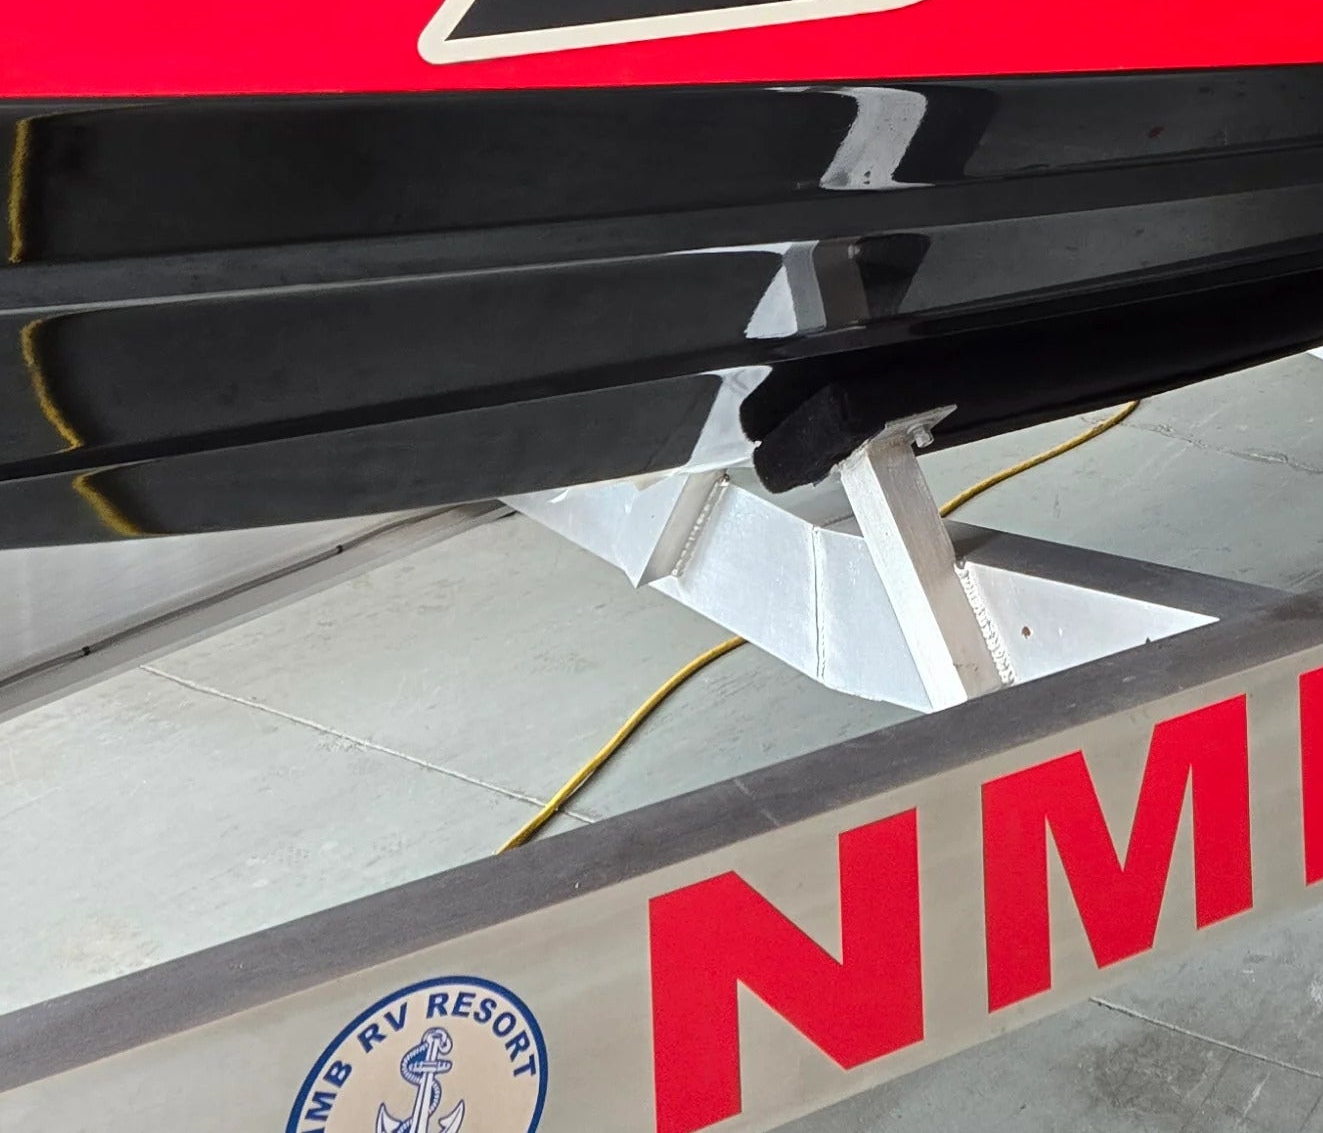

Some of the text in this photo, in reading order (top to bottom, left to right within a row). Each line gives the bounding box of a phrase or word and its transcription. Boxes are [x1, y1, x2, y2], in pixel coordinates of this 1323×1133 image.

[301, 991, 537, 1133] MB RV RESORT
